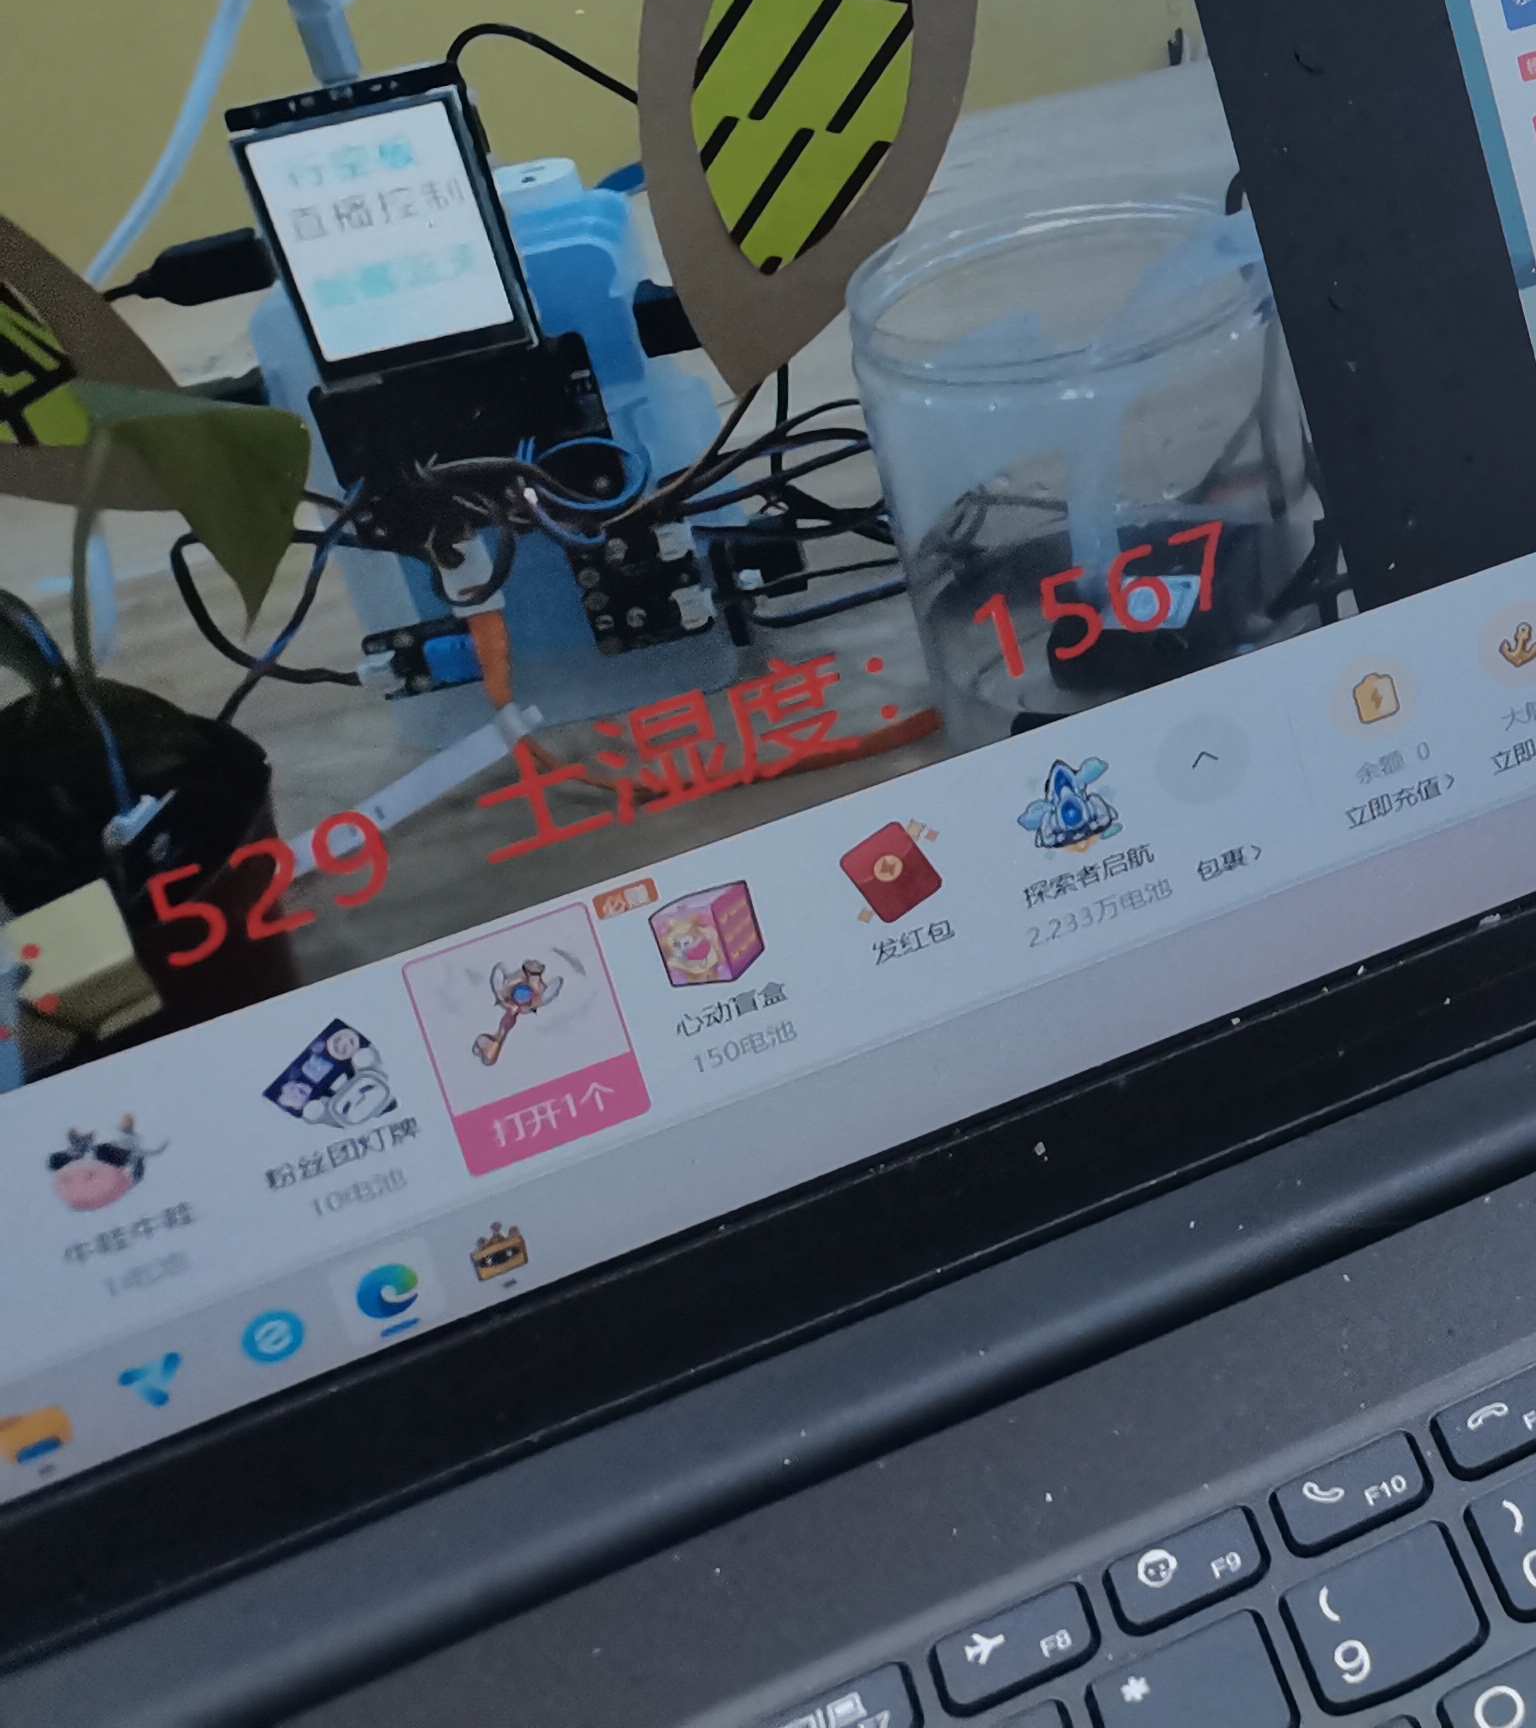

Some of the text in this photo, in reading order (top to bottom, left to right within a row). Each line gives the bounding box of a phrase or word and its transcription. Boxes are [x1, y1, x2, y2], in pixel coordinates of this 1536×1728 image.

[147, 812, 388, 970] 529
[973, 521, 1224, 678] 1567
[873, 920, 955, 965] 发红包
[693, 1020, 797, 1073] 150电池
[490, 1082, 614, 1147] 打开1个
[1363, 1475, 1407, 1506] F10
[1210, 1552, 1242, 1579] F9
[1040, 1629, 1072, 1658] F8
[1332, 1639, 1371, 1684] 9
